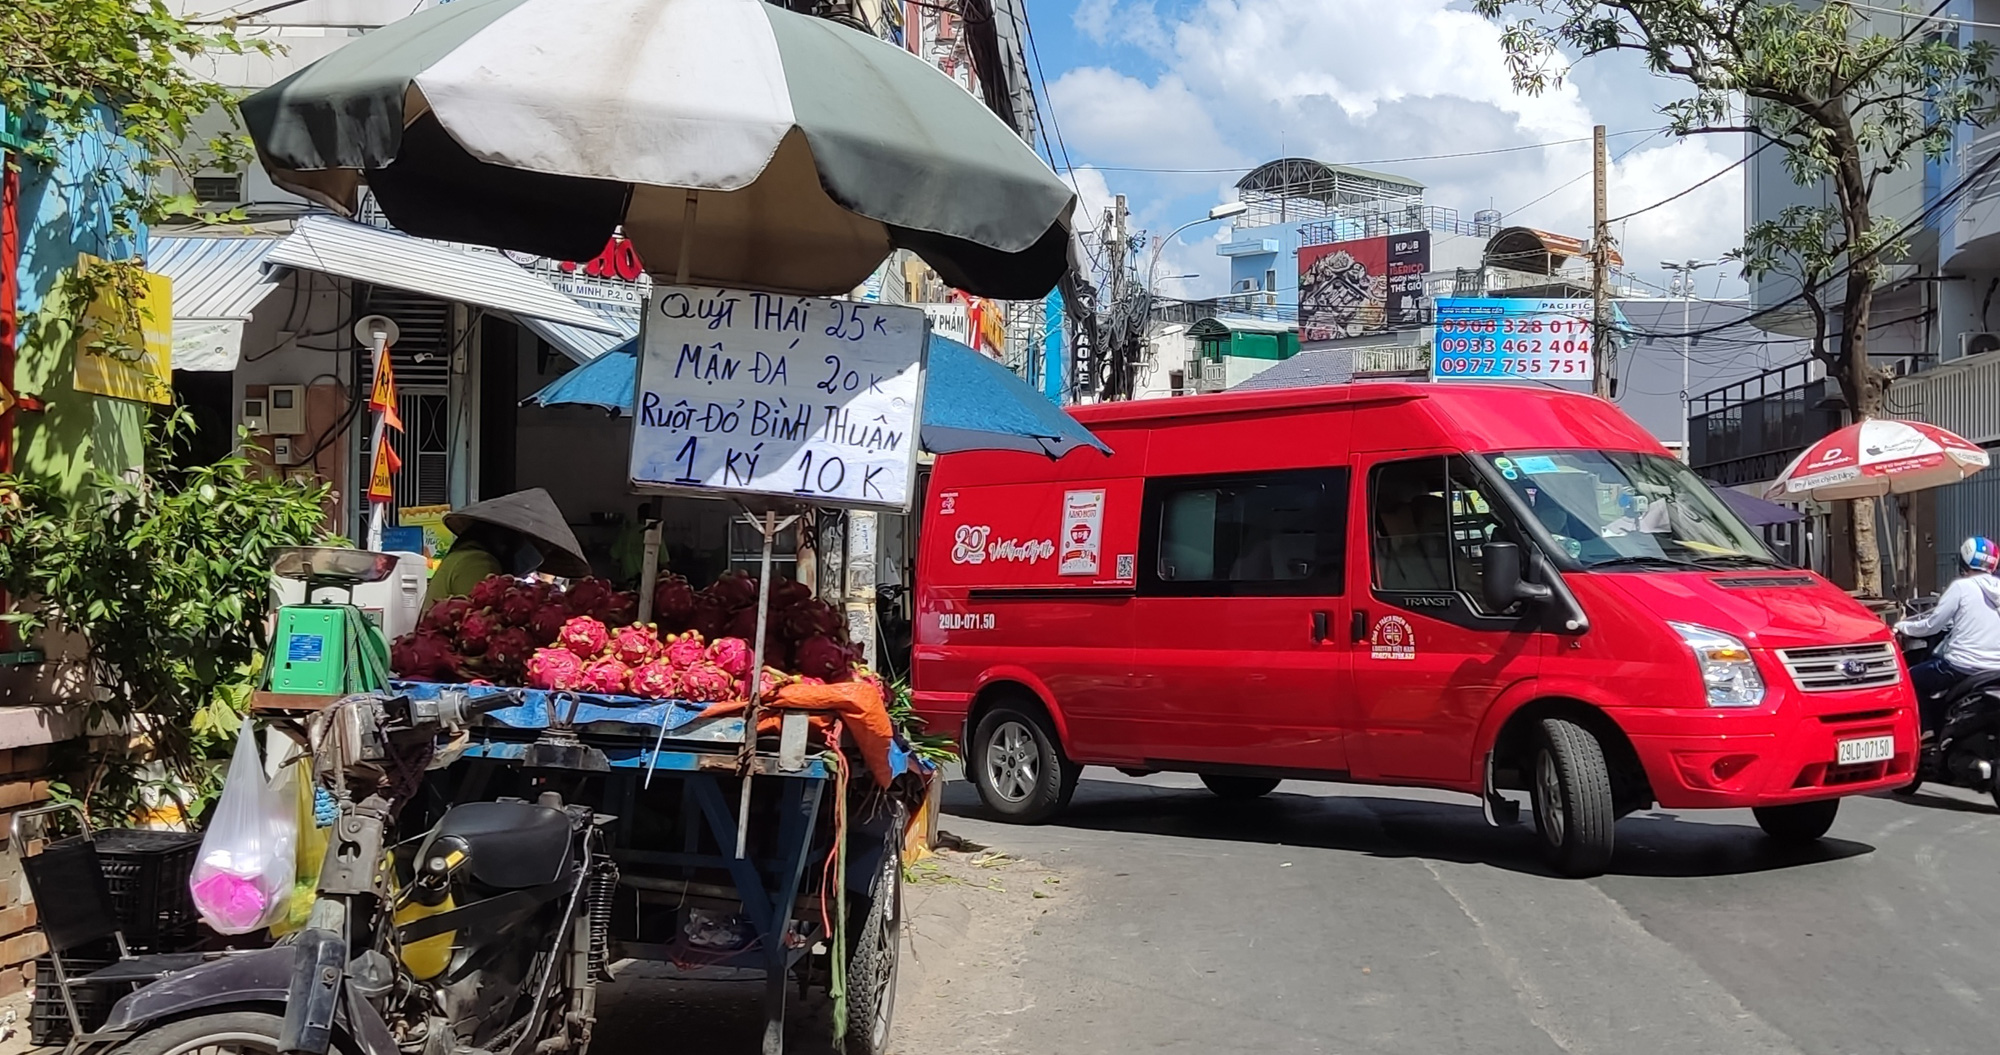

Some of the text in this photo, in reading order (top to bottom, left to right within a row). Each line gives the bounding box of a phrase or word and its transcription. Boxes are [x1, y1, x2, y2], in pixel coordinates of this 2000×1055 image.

[1541, 302, 1591, 310] PACIFIC
[1502, 319, 1543, 334] 328
[1549, 319, 1590, 334] 017
[1441, 339, 1590, 354] 0933 462 404
[1441, 358, 1587, 374] 0977 755 751
[675, 436, 702, 483] 1
[1403, 597, 1453, 607] TRANSIT
